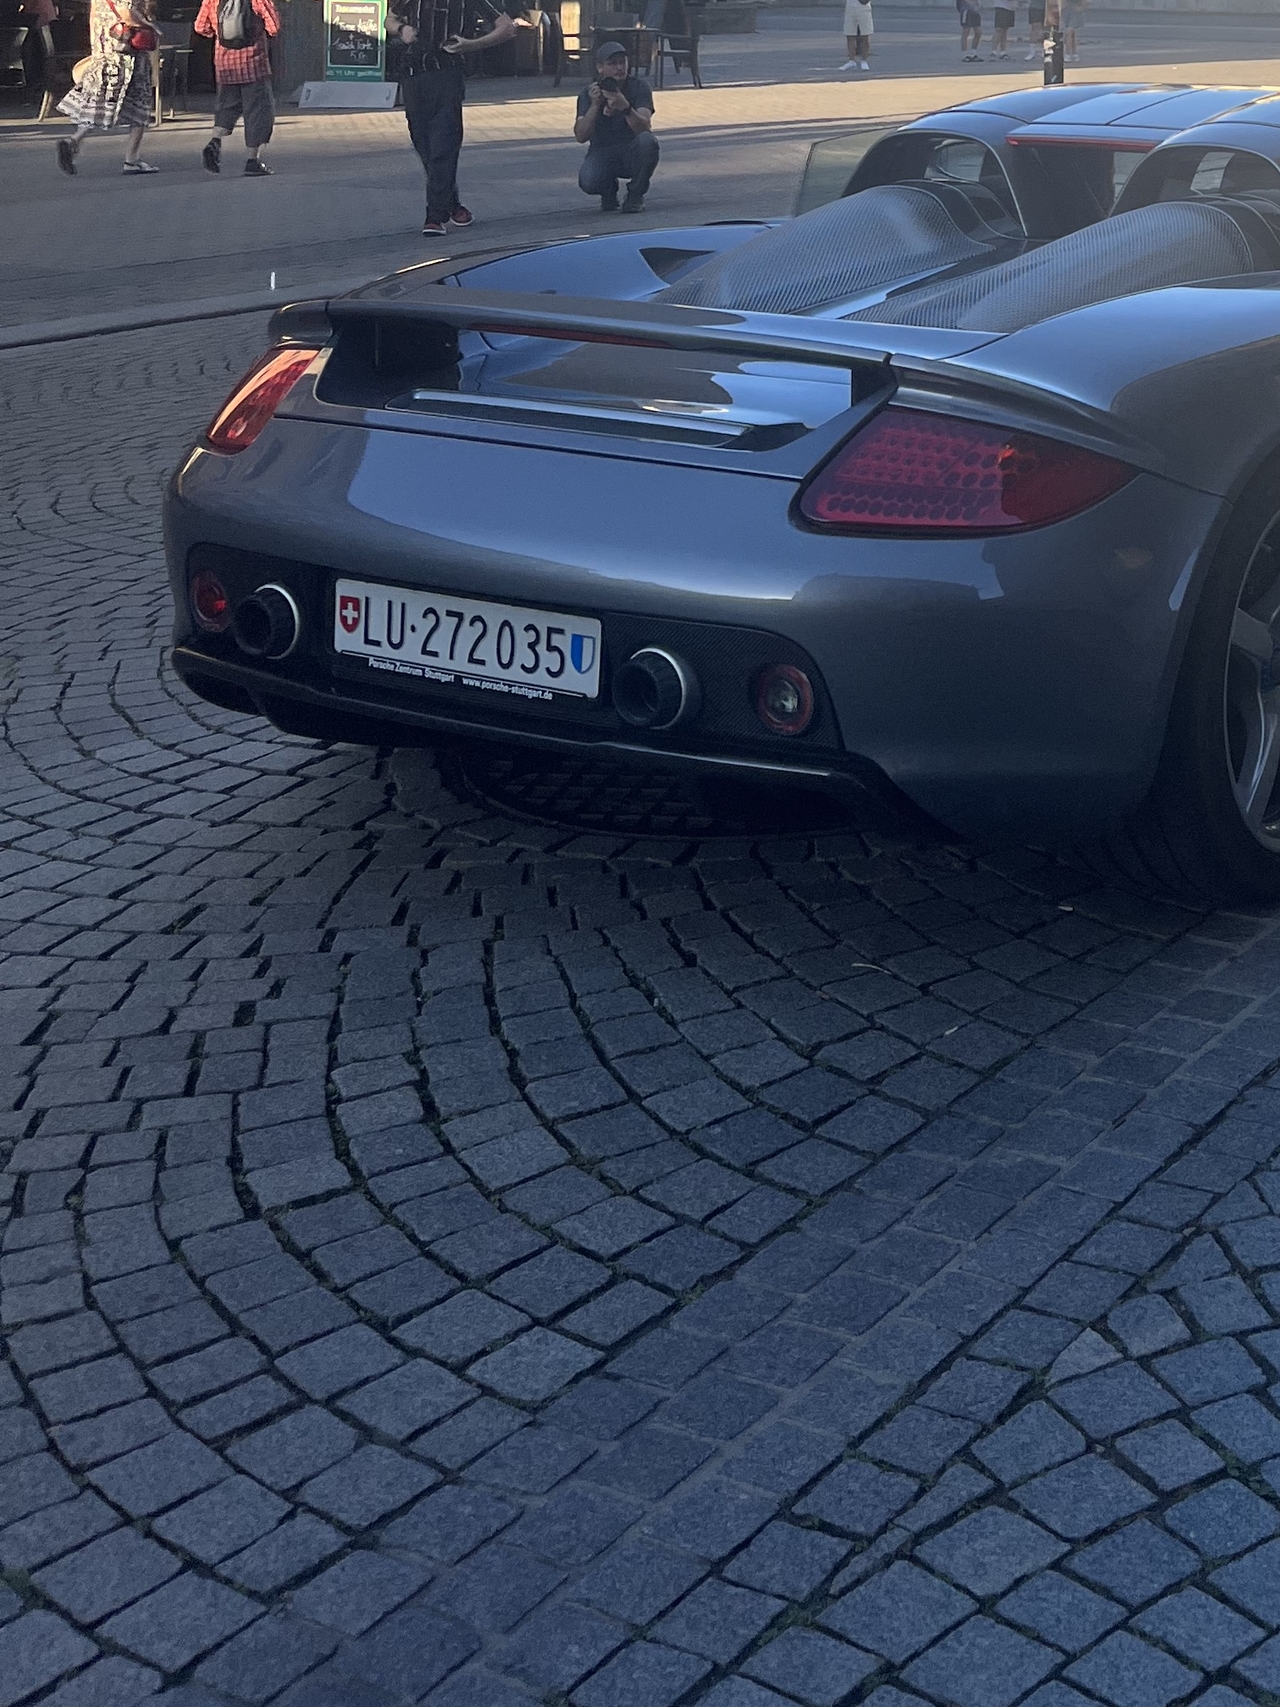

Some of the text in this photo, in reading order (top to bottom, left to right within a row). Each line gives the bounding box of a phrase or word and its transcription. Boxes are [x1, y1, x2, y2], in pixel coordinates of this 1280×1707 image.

[368, 658, 554, 700] Porsche Zentrum Stuttgart www.porsche-stuttgart.de
